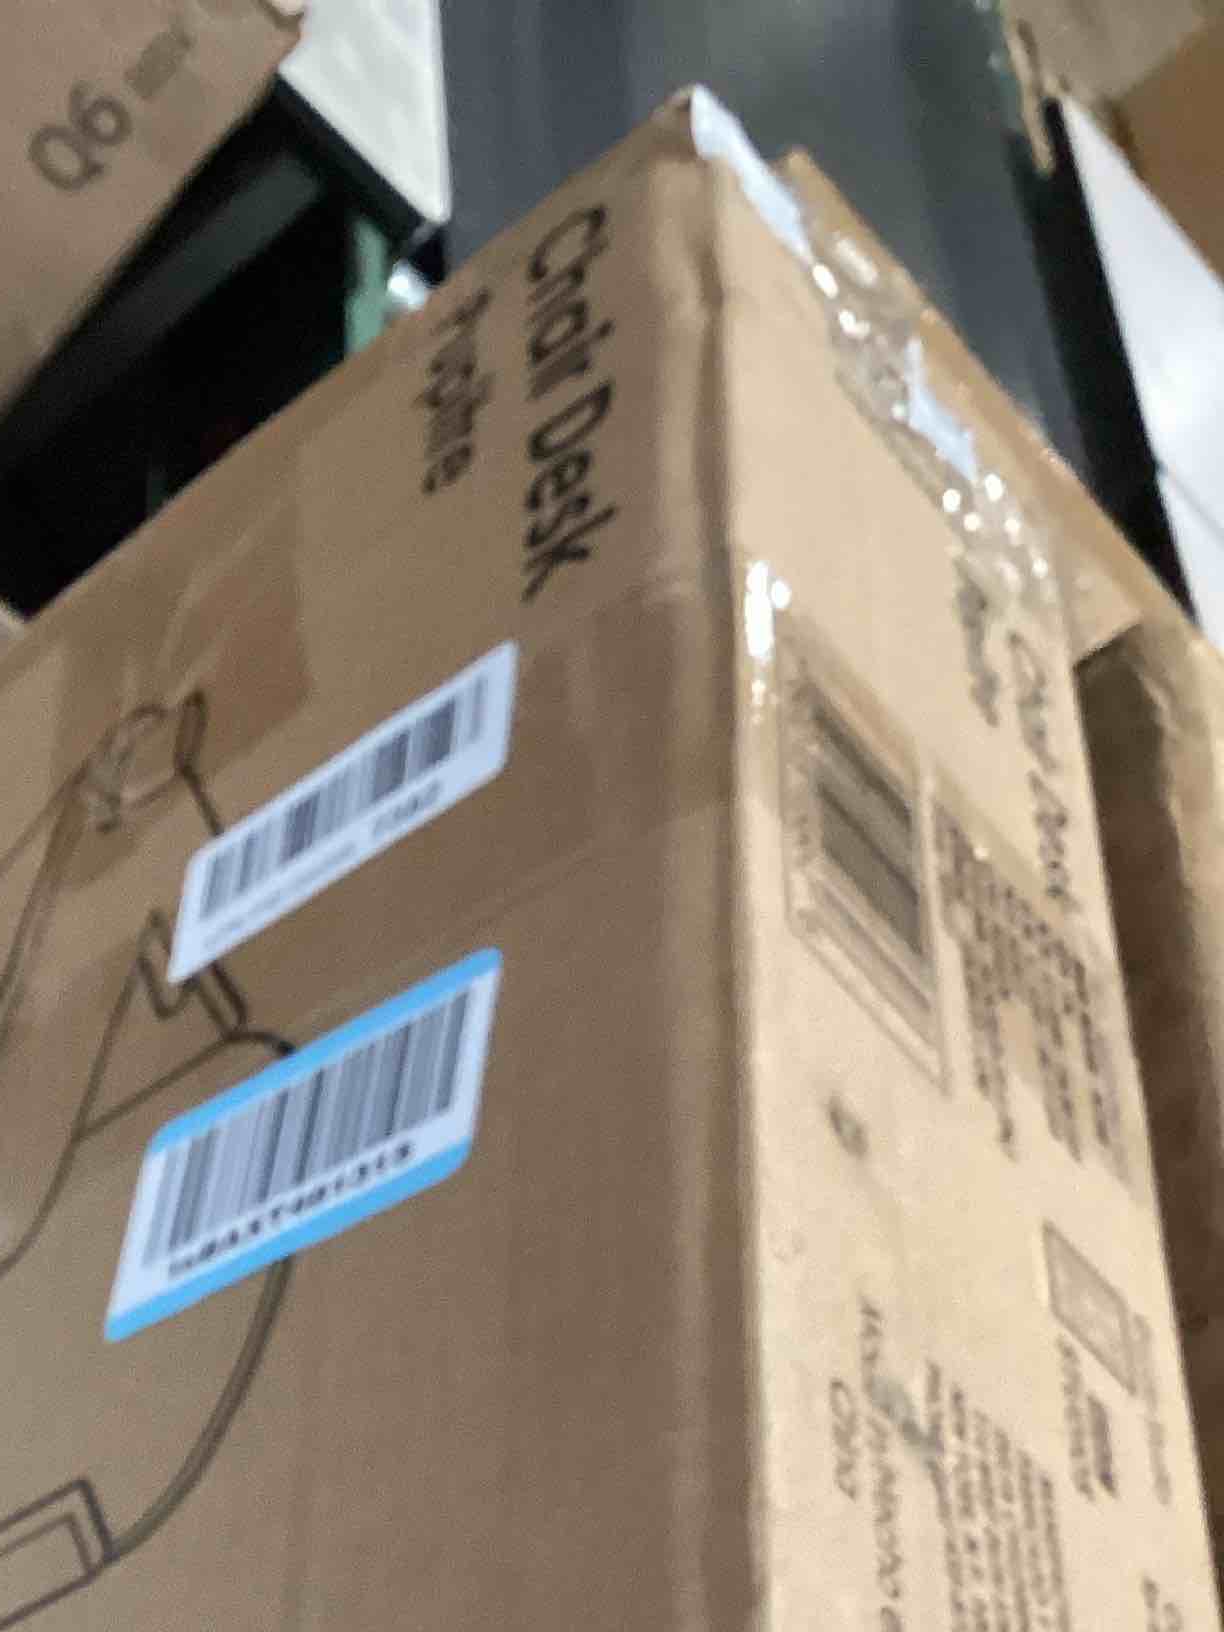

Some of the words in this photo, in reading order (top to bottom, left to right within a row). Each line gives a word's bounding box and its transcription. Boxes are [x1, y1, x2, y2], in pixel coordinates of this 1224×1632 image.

[28, 78, 133, 191] Q6
[526, 204, 614, 402] Chair
[519, 382, 619, 603] Desk
